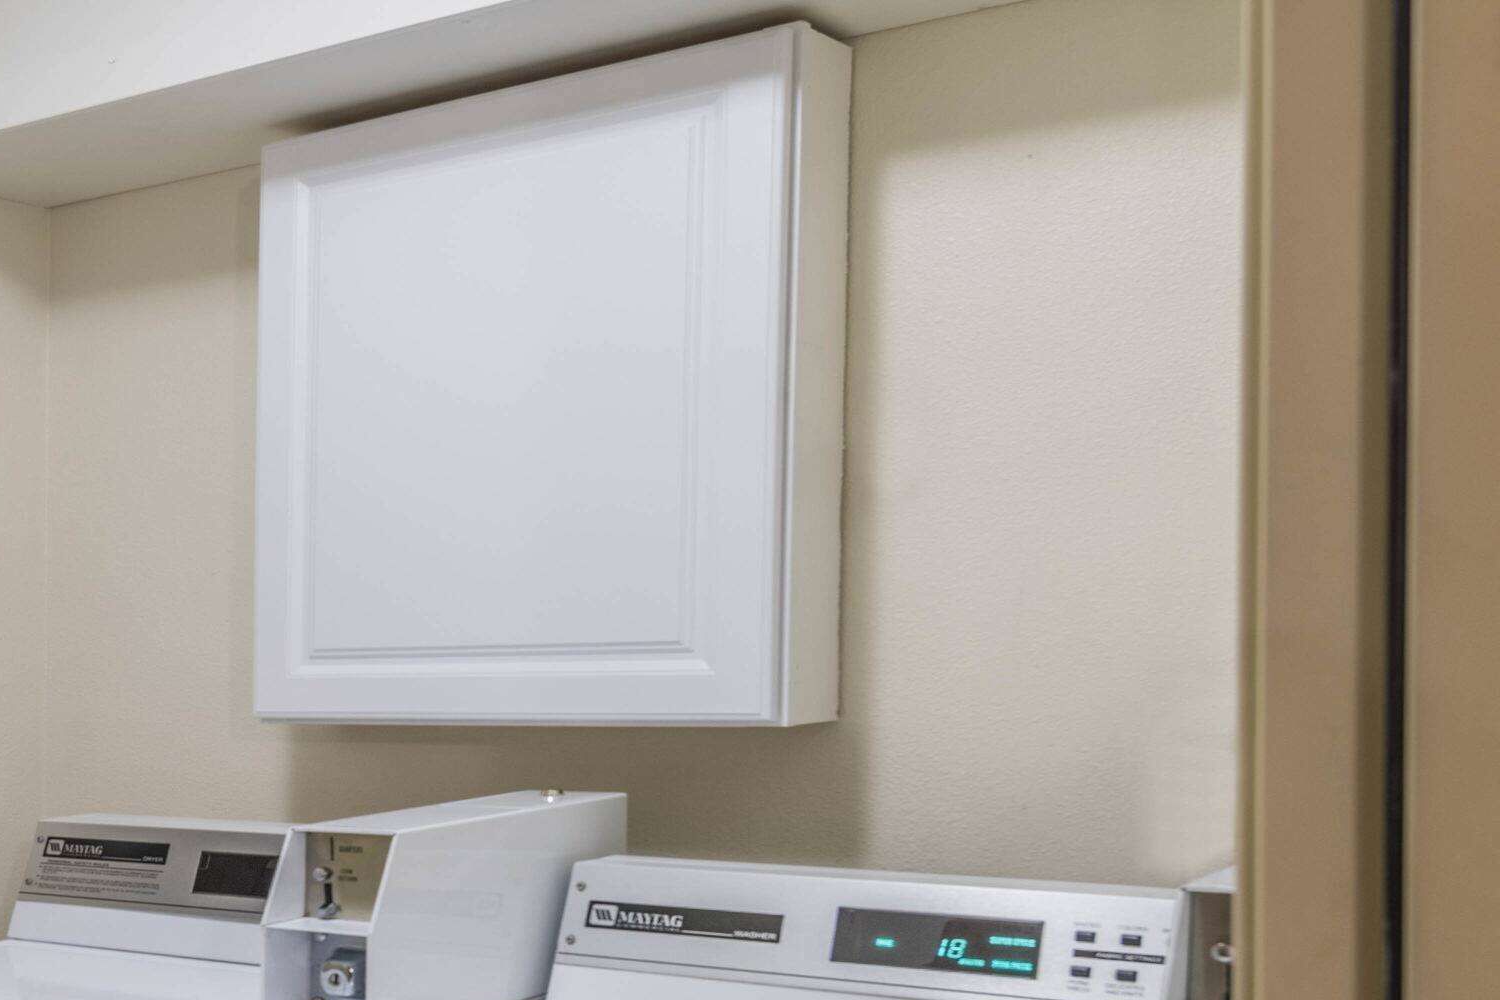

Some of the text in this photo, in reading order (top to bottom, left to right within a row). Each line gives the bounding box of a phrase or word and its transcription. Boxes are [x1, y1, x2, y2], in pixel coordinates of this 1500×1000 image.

[62, 843, 104, 856] MAYTAG
[617, 909, 685, 929] MAYTAG
[937, 937, 969, 959] 18
